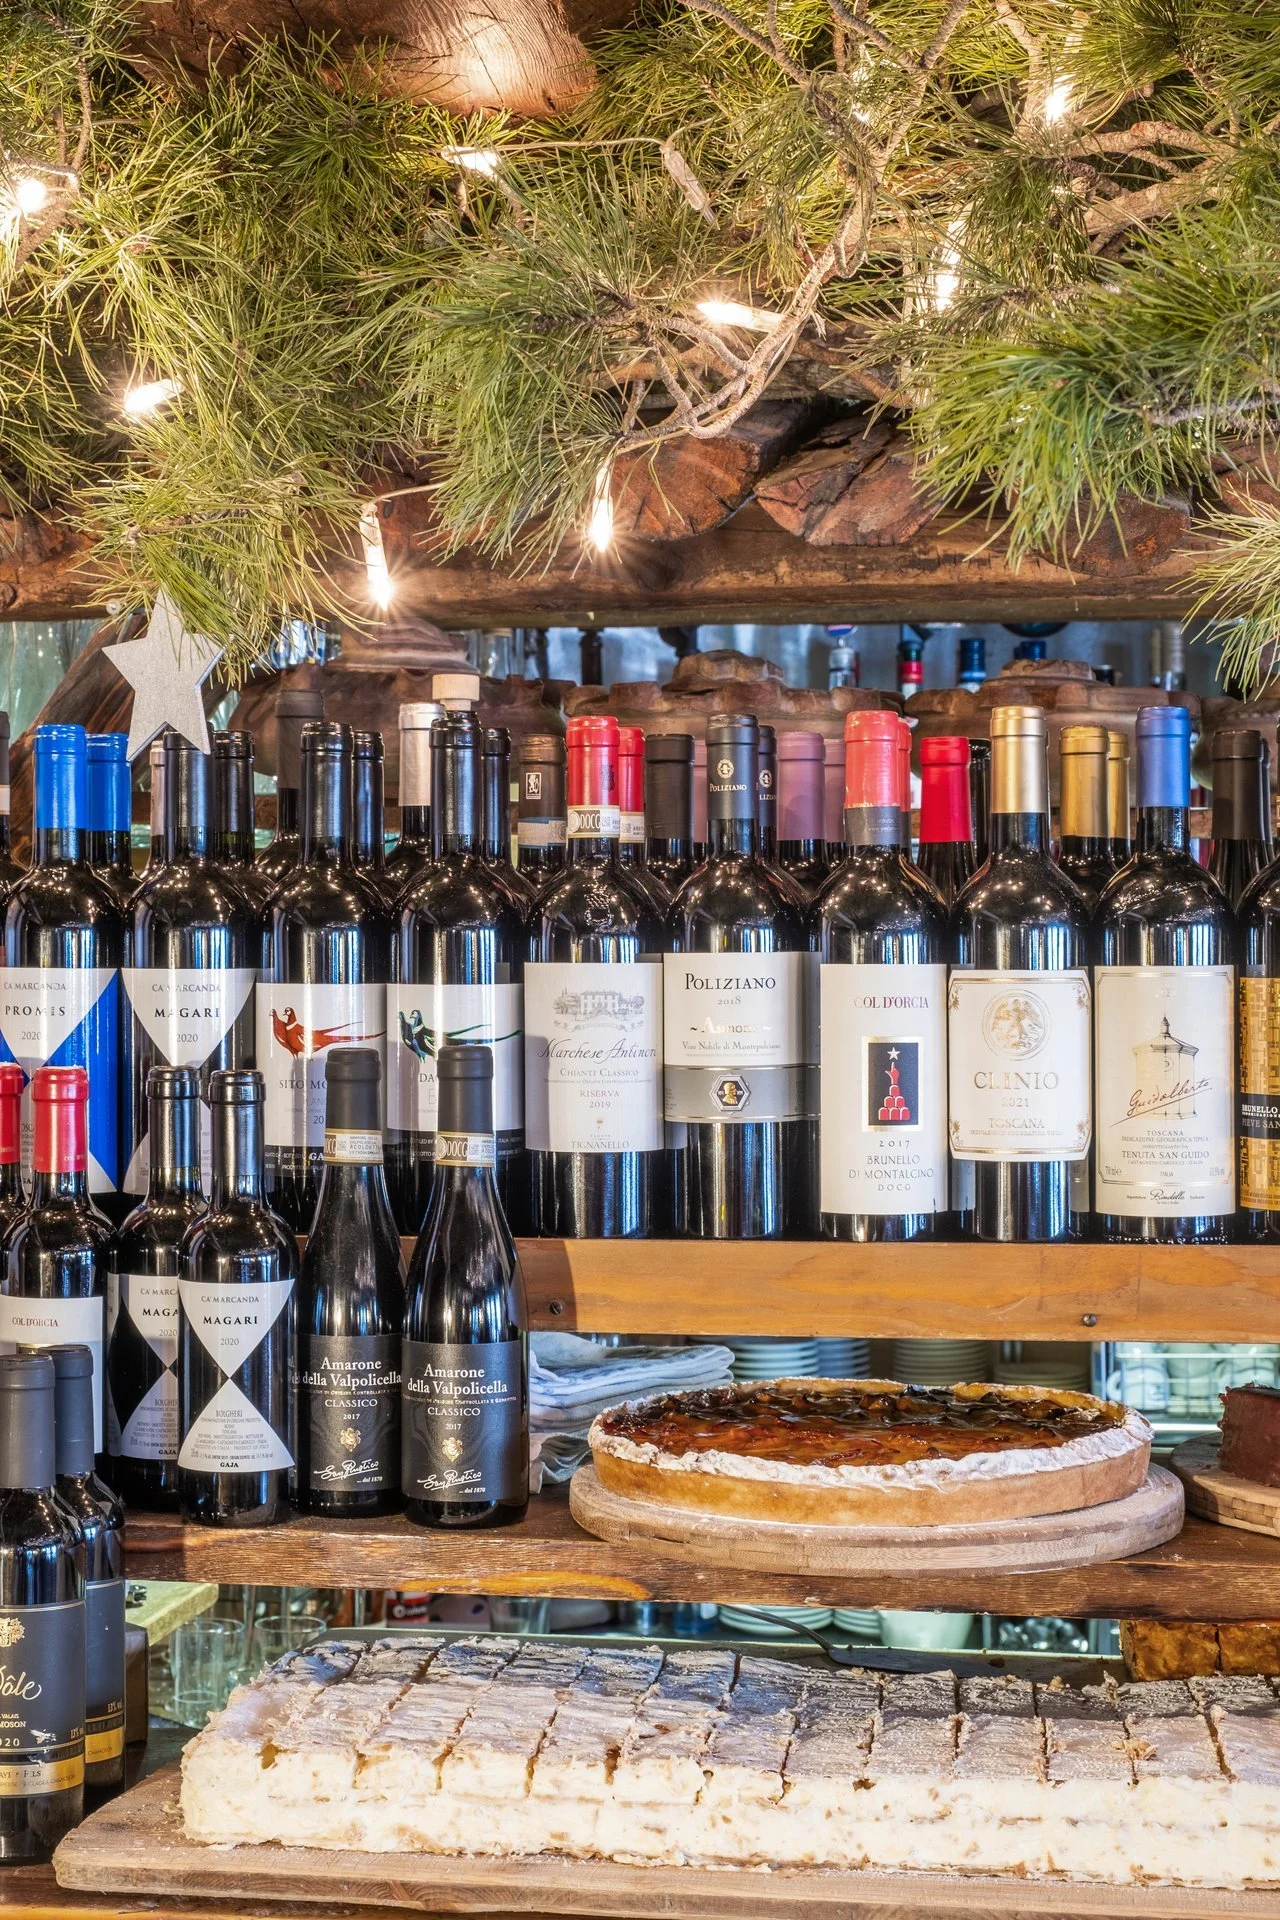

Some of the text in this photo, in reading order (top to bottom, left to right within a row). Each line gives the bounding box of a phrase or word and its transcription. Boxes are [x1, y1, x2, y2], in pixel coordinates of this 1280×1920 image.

[709, 783, 747, 792] POLIZIANO
[684, 973, 777, 991] POLIZIANO
[717, 996, 742, 1006] 2018
[853, 996, 929, 1009] COL D'ORCIA
[20, 1031, 41, 1041] 2020
[176, 1033, 199, 1043] 2020
[538, 1038, 658, 1065] Marchese Antinori
[682, 1041, 782, 1053] Vino Nobile di Montepulciano
[559, 1067, 639, 1077] CHIANTI CLASSICO
[279, 1079, 305, 1090] SITO
[973, 1071, 1060, 1090] CLINIO
[579, 1090, 620, 1098] RISERVA
[1127, 1077, 1211, 1117] Guidalberto
[588, 1101, 612, 1109] 2019
[1001, 1097, 1030, 1108] 2021
[1241, 1104, 1279, 1114] BRUNELLO
[988, 1118, 1045, 1129] TOSCANA
[570, 1140, 630, 1150] TIGNANELLO
[879, 1140, 910, 1149] 2017
[866, 1154, 921, 1165] BRUNELLO
[1121, 1150, 1210, 1159] TENUTA SAN GUIDO
[848, 1168, 934, 1180] DI MONTALCINO
[877, 1183, 912, 1192] DOCG
[140, 1288, 151, 1296] CA'
[200, 1295, 260, 1304] CA' MARCANDA
[12, 1317, 59, 1328] COL D'ORCIA
[202, 1315, 258, 1325] MAGARI
[159, 1329, 178, 1337] 2020
[219, 1337, 240, 1346] 2020
[320, 1356, 382, 1371] Amarone
[423, 1363, 486, 1378] Amarone
[302, 1371, 328, 1386] della
[329, 1371, 402, 1391] Valpolicella
[407, 1377, 431, 1394] della
[432, 1379, 508, 1399] Valpolicella
[324, 1398, 378, 1408] CLASSICO
[215, 1409, 243, 1418] BOLGHERI
[427, 1406, 481, 1417] CLASSICO
[343, 1413, 361, 1421] 2017
[445, 1423, 462, 1431] 2017
[23, 1769, 42, 1778] FLS
